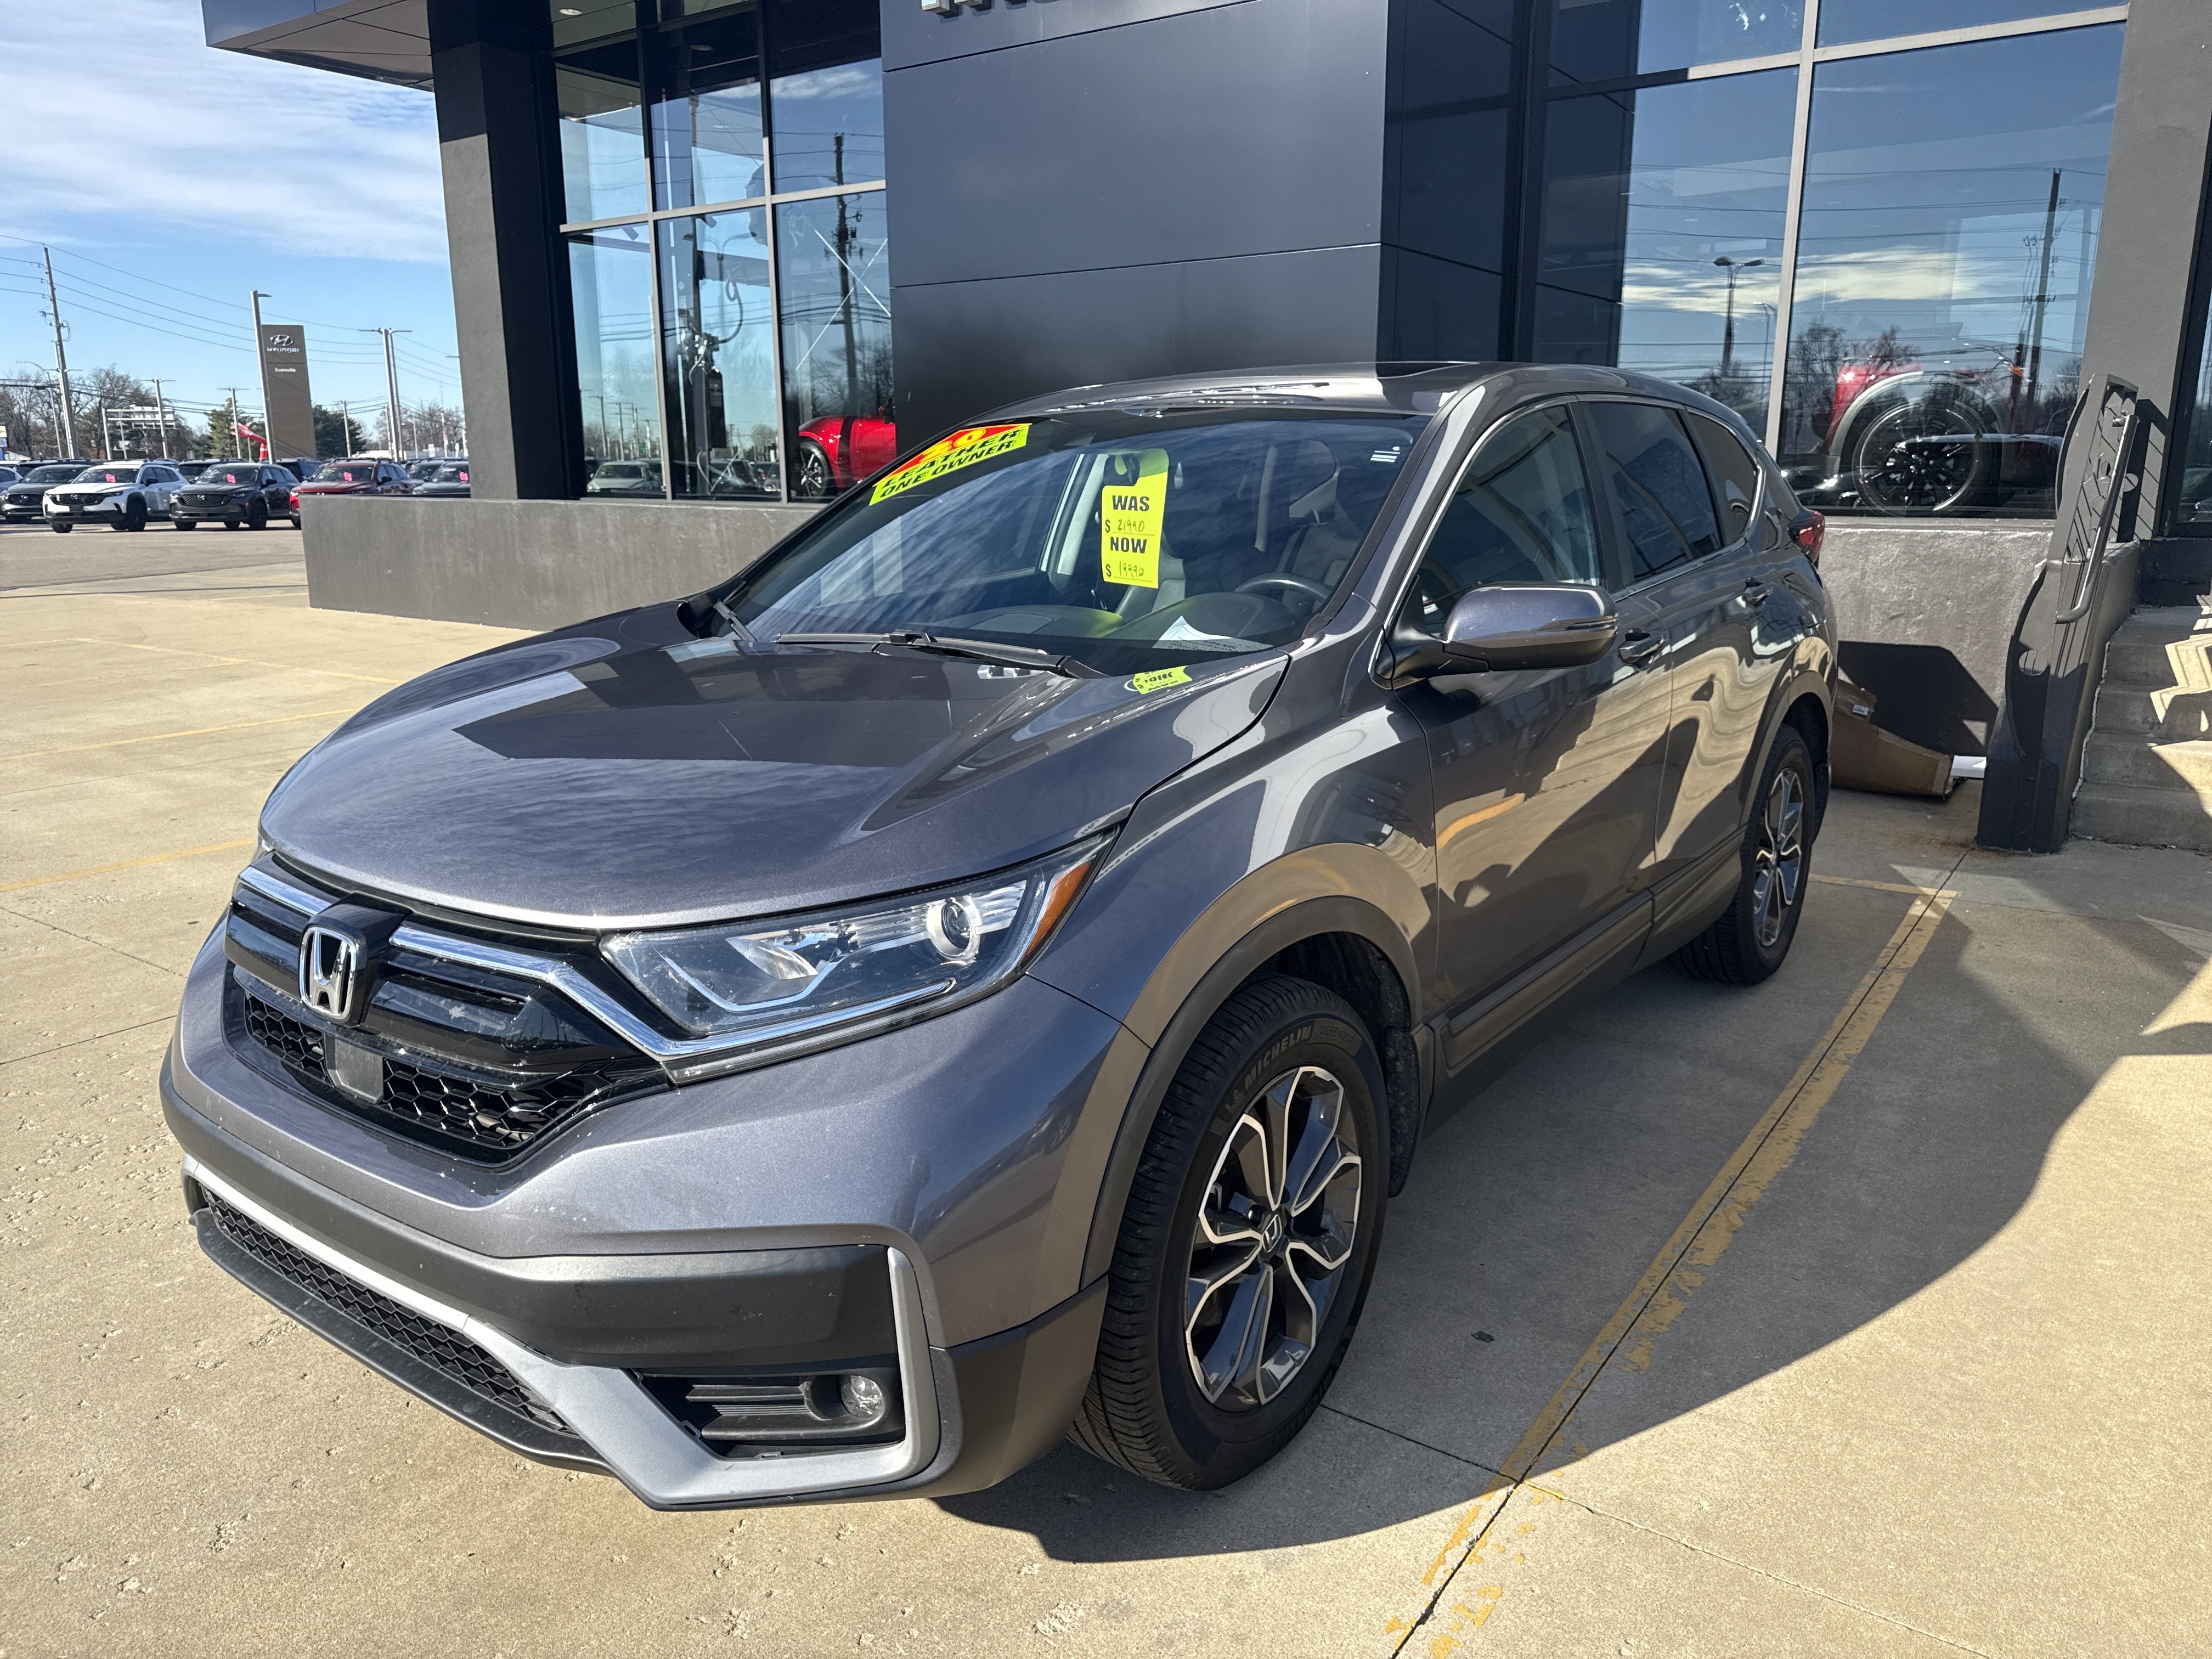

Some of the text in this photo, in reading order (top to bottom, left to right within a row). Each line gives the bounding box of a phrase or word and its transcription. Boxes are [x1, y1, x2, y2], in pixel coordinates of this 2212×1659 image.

[882, 428, 1024, 489] LEATHER
[880, 439, 1016, 498] ONE OWNER
[1112, 495, 1150, 512] WAS
[1105, 518, 1111, 534] $
[1110, 536, 1148, 554] NOW
[1105, 563, 1112, 578] $
[1244, 1025, 1312, 1091] MICHELIN
